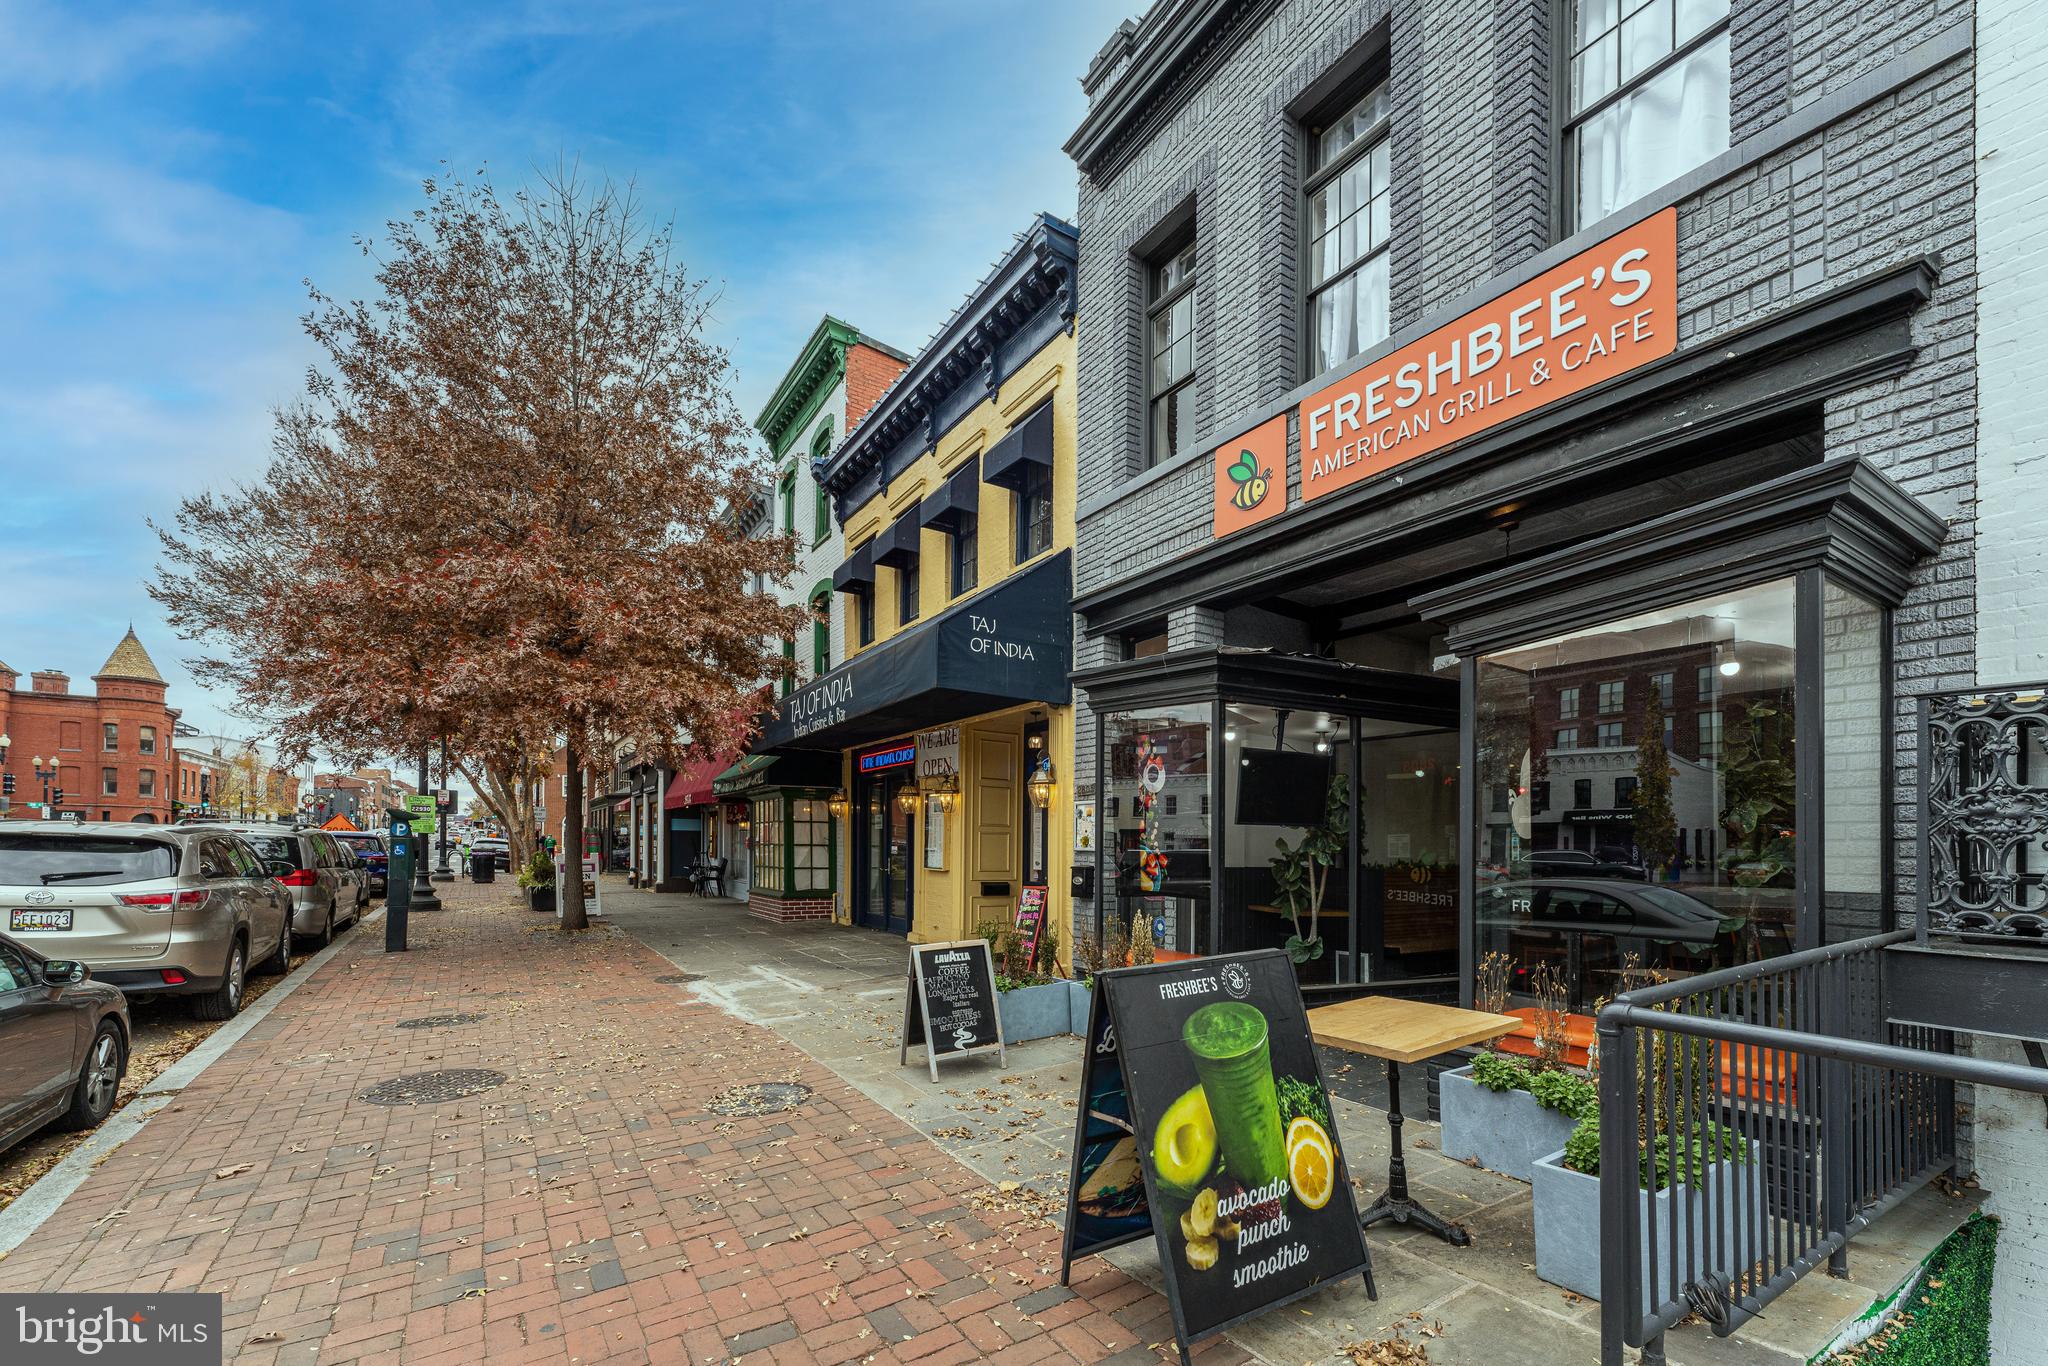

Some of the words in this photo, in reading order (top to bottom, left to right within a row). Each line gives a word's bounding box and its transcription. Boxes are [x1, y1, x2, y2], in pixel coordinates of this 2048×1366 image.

[1308, 247, 1652, 451] FRESHBEE'S
[1310, 407, 1431, 482] AMERICAN
[1438, 374, 1522, 425] GRILL
[1529, 357, 1551, 387] &
[1561, 308, 1655, 372] CAFE
[969, 615, 997, 634] TAJ
[970, 637, 992, 654] OF
[994, 640, 1035, 661] INDIA
[790, 694, 806, 723] TAJ
[807, 687, 822, 716] OF
[822, 672, 853, 710] INDIA
[828, 710, 834, 726] &
[835, 706, 846, 723] Bar
[917, 732, 934, 750] WE
[936, 727, 959, 747] ARE
[922, 756, 953, 777] OPEN
[396, 823, 407, 836] P
[934, 950, 971, 964] LAVAZZA
[938, 965, 971, 977] COFFEE
[1160, 976, 1218, 1000] FRESHBEE'S
[940, 1023, 953, 1032] HOT
[1217, 1175, 1291, 1218] avocado
[1237, 1210, 1291, 1255] punch
[1233, 1241, 1310, 1289] smoothie
